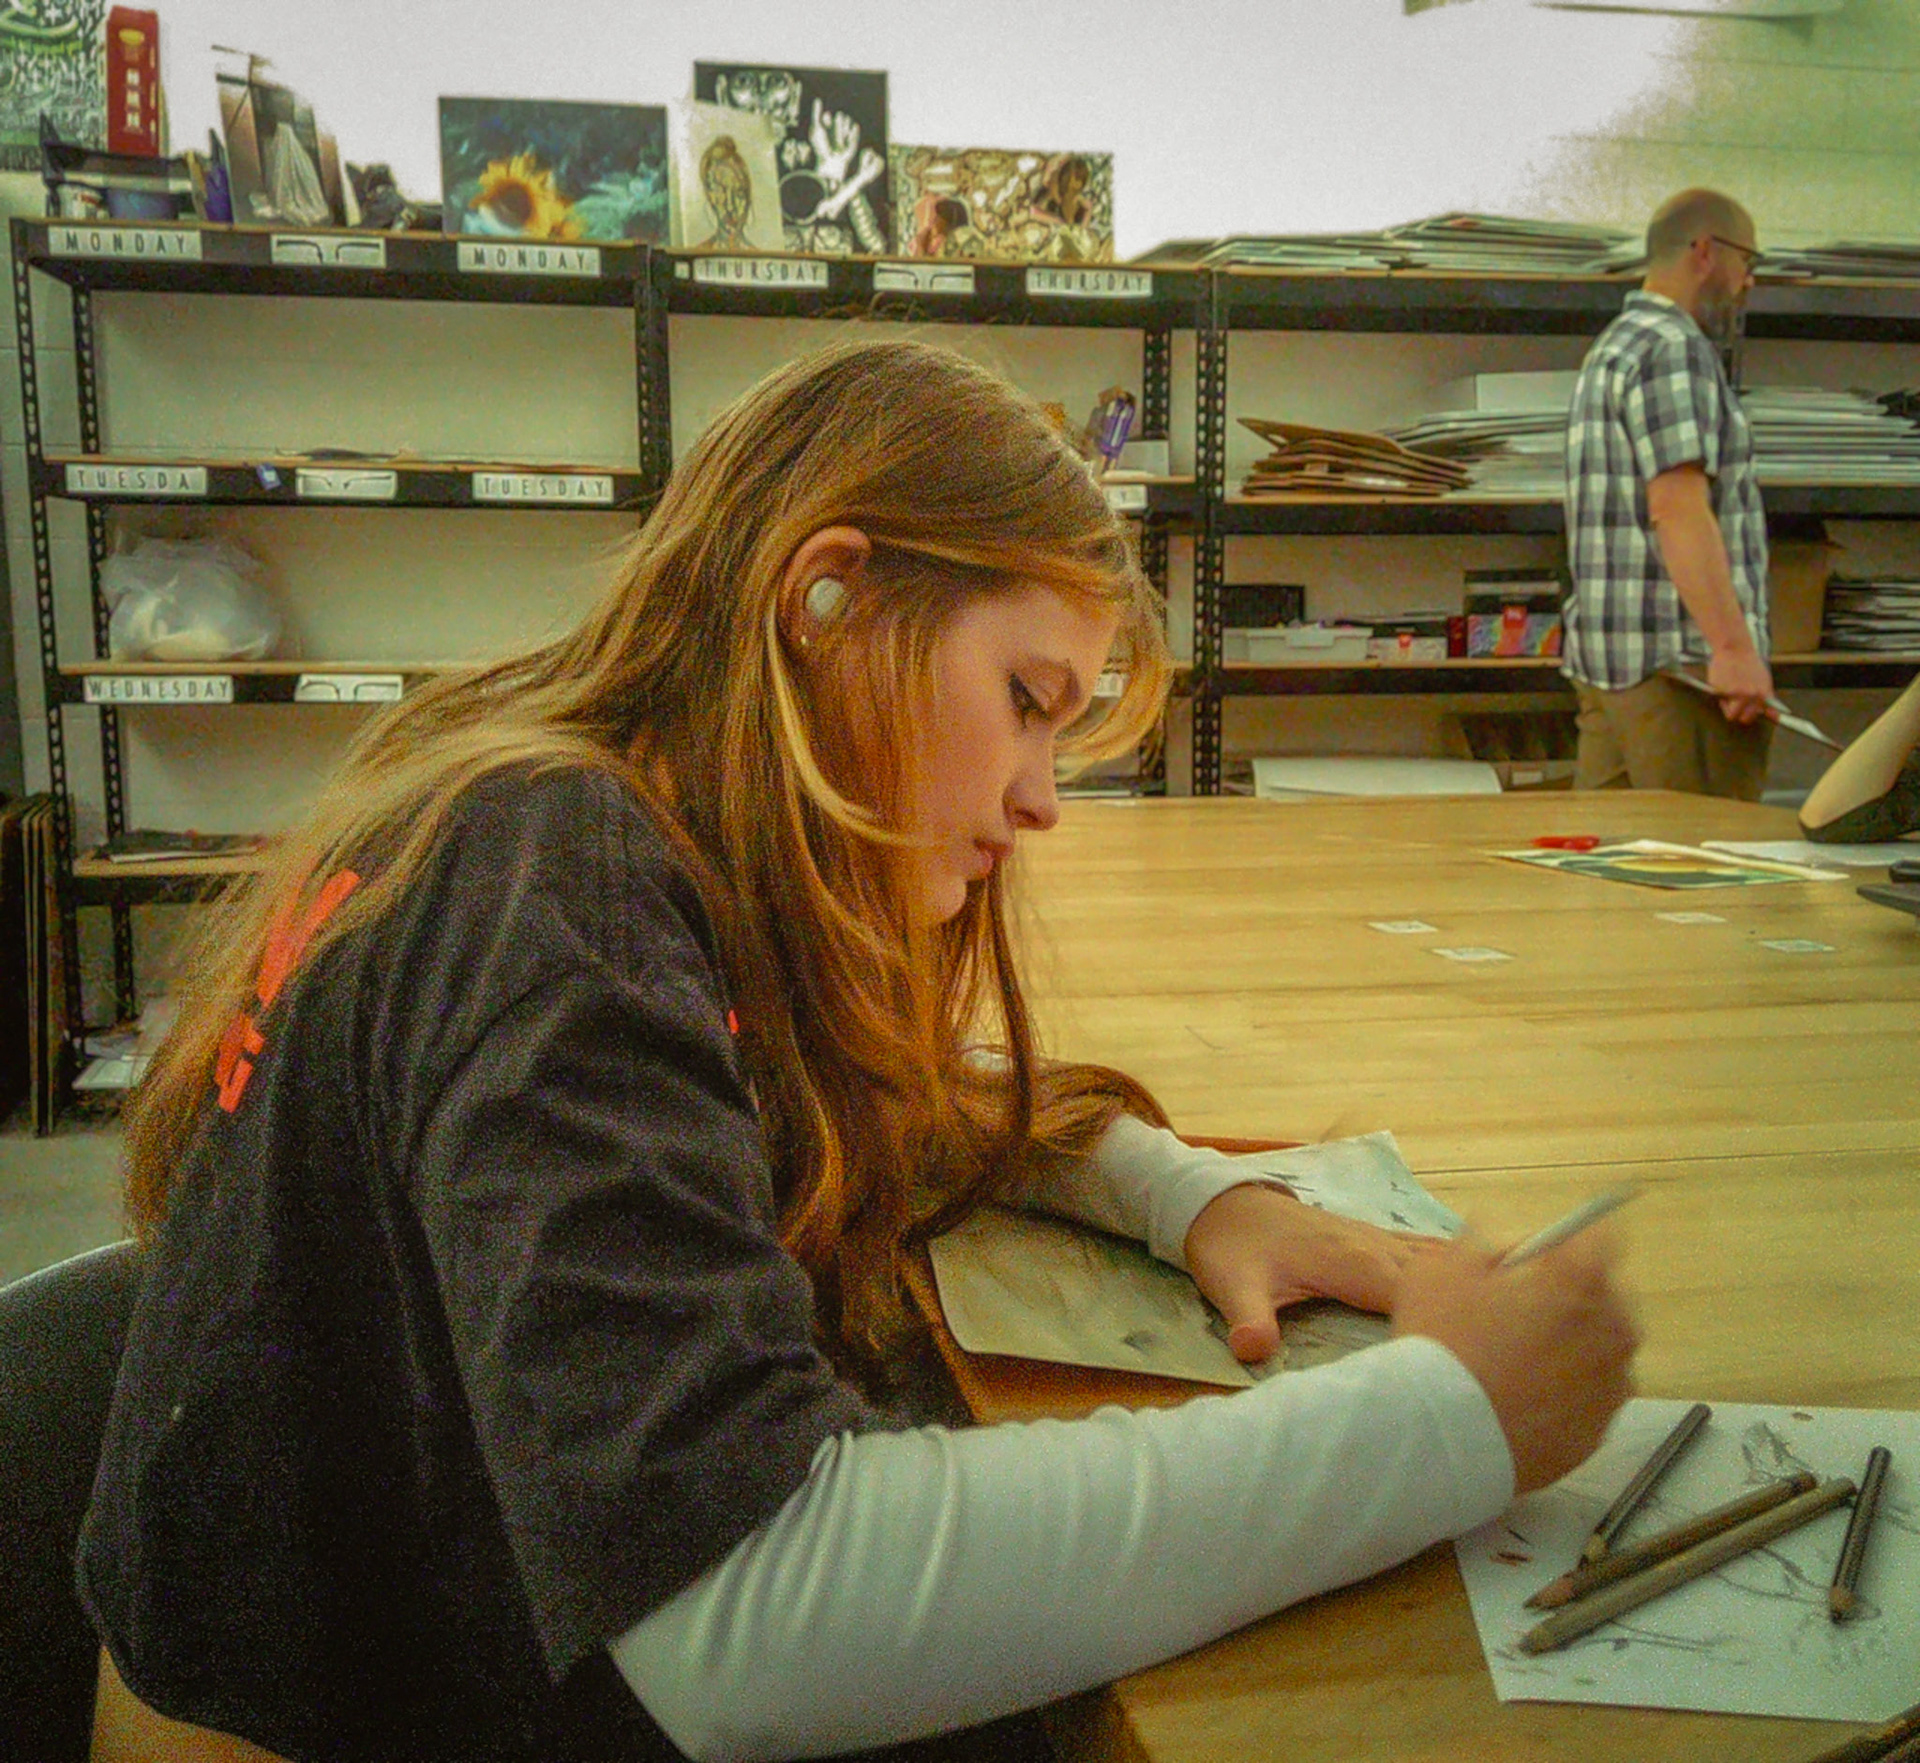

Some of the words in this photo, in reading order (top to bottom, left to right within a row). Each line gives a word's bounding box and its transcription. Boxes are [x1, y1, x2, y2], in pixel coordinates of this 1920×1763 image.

[65, 230, 185, 253] MONDAY
[473, 247, 585, 270] MONDAY
[704, 259, 818, 282] THURSDAY
[1036, 272, 1143, 292] THURSDAY
[77, 470, 190, 490] TUESDA
[484, 477, 606, 497] TUESDAY
[88, 680, 229, 699] WEDNESDAY
